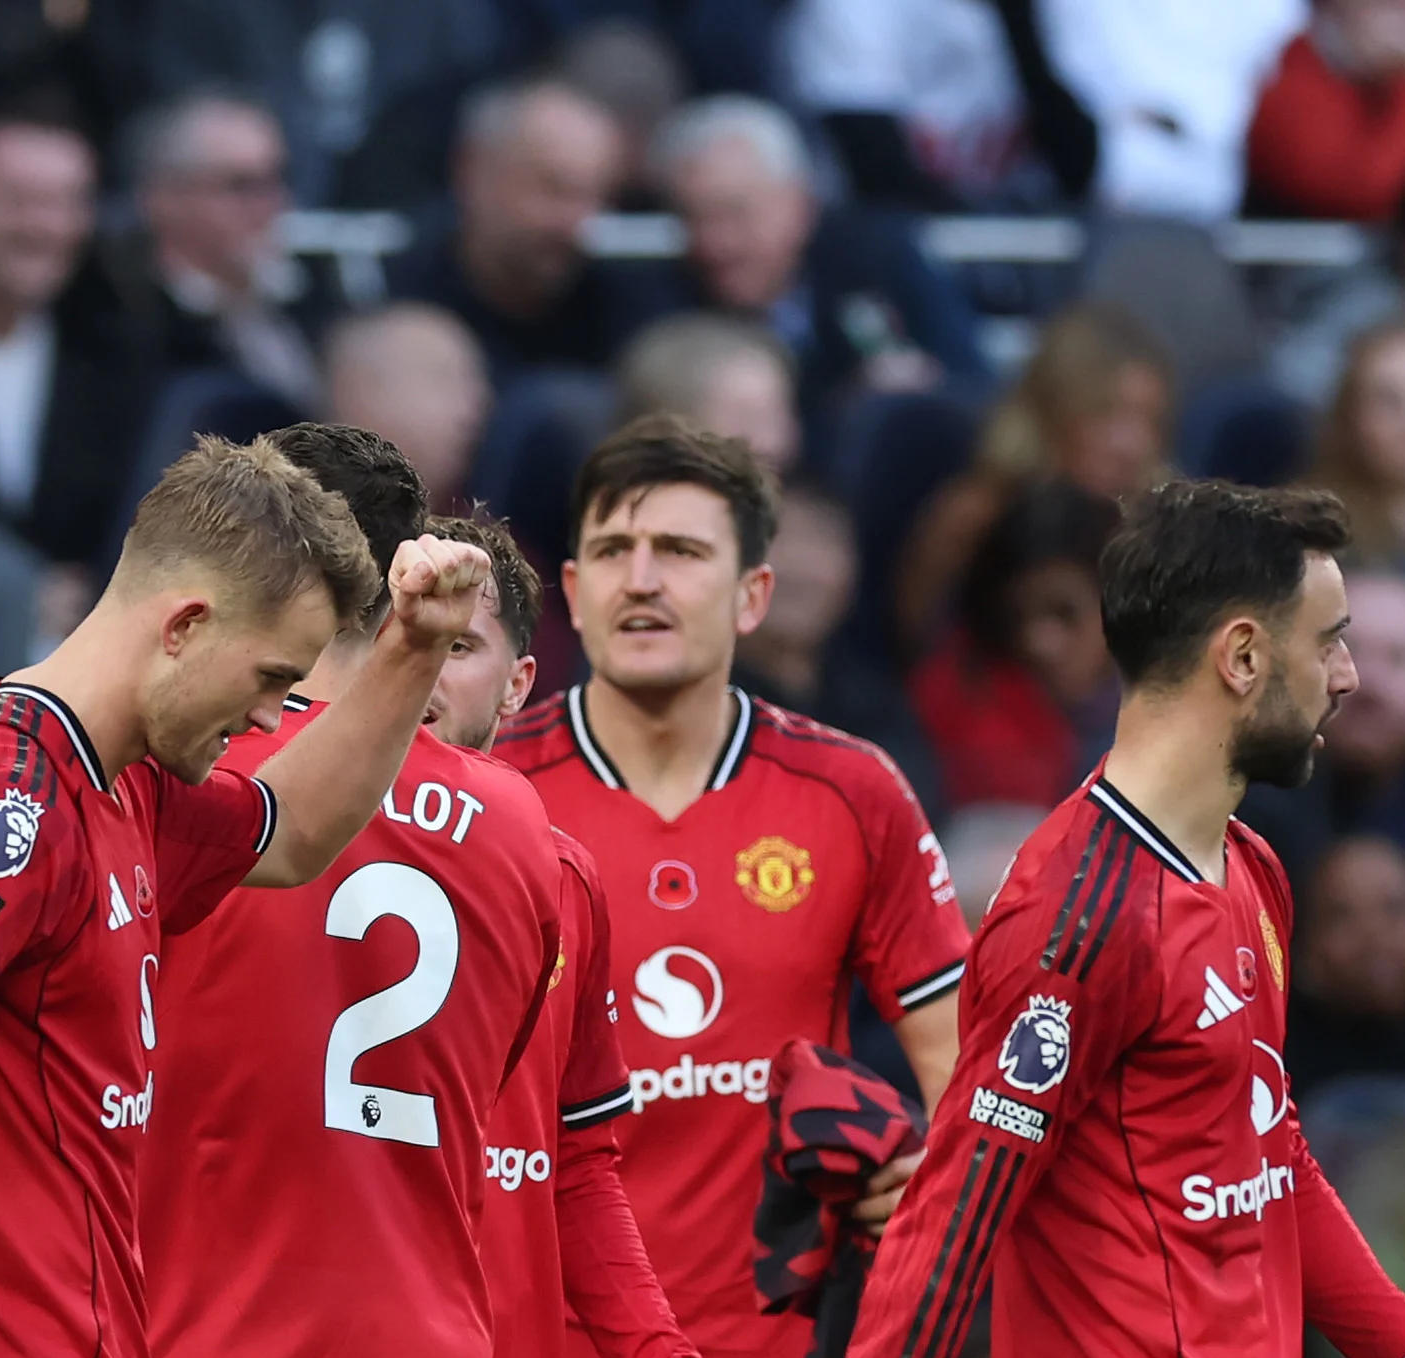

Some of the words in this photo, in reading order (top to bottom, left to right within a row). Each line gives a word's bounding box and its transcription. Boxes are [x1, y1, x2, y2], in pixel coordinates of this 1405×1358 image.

[325, 862, 459, 1147] 2
[969, 1103, 993, 1124] for
[992, 1112, 1045, 1143] racism
[975, 1087, 998, 1109] No
[998, 1097, 1044, 1126] room
